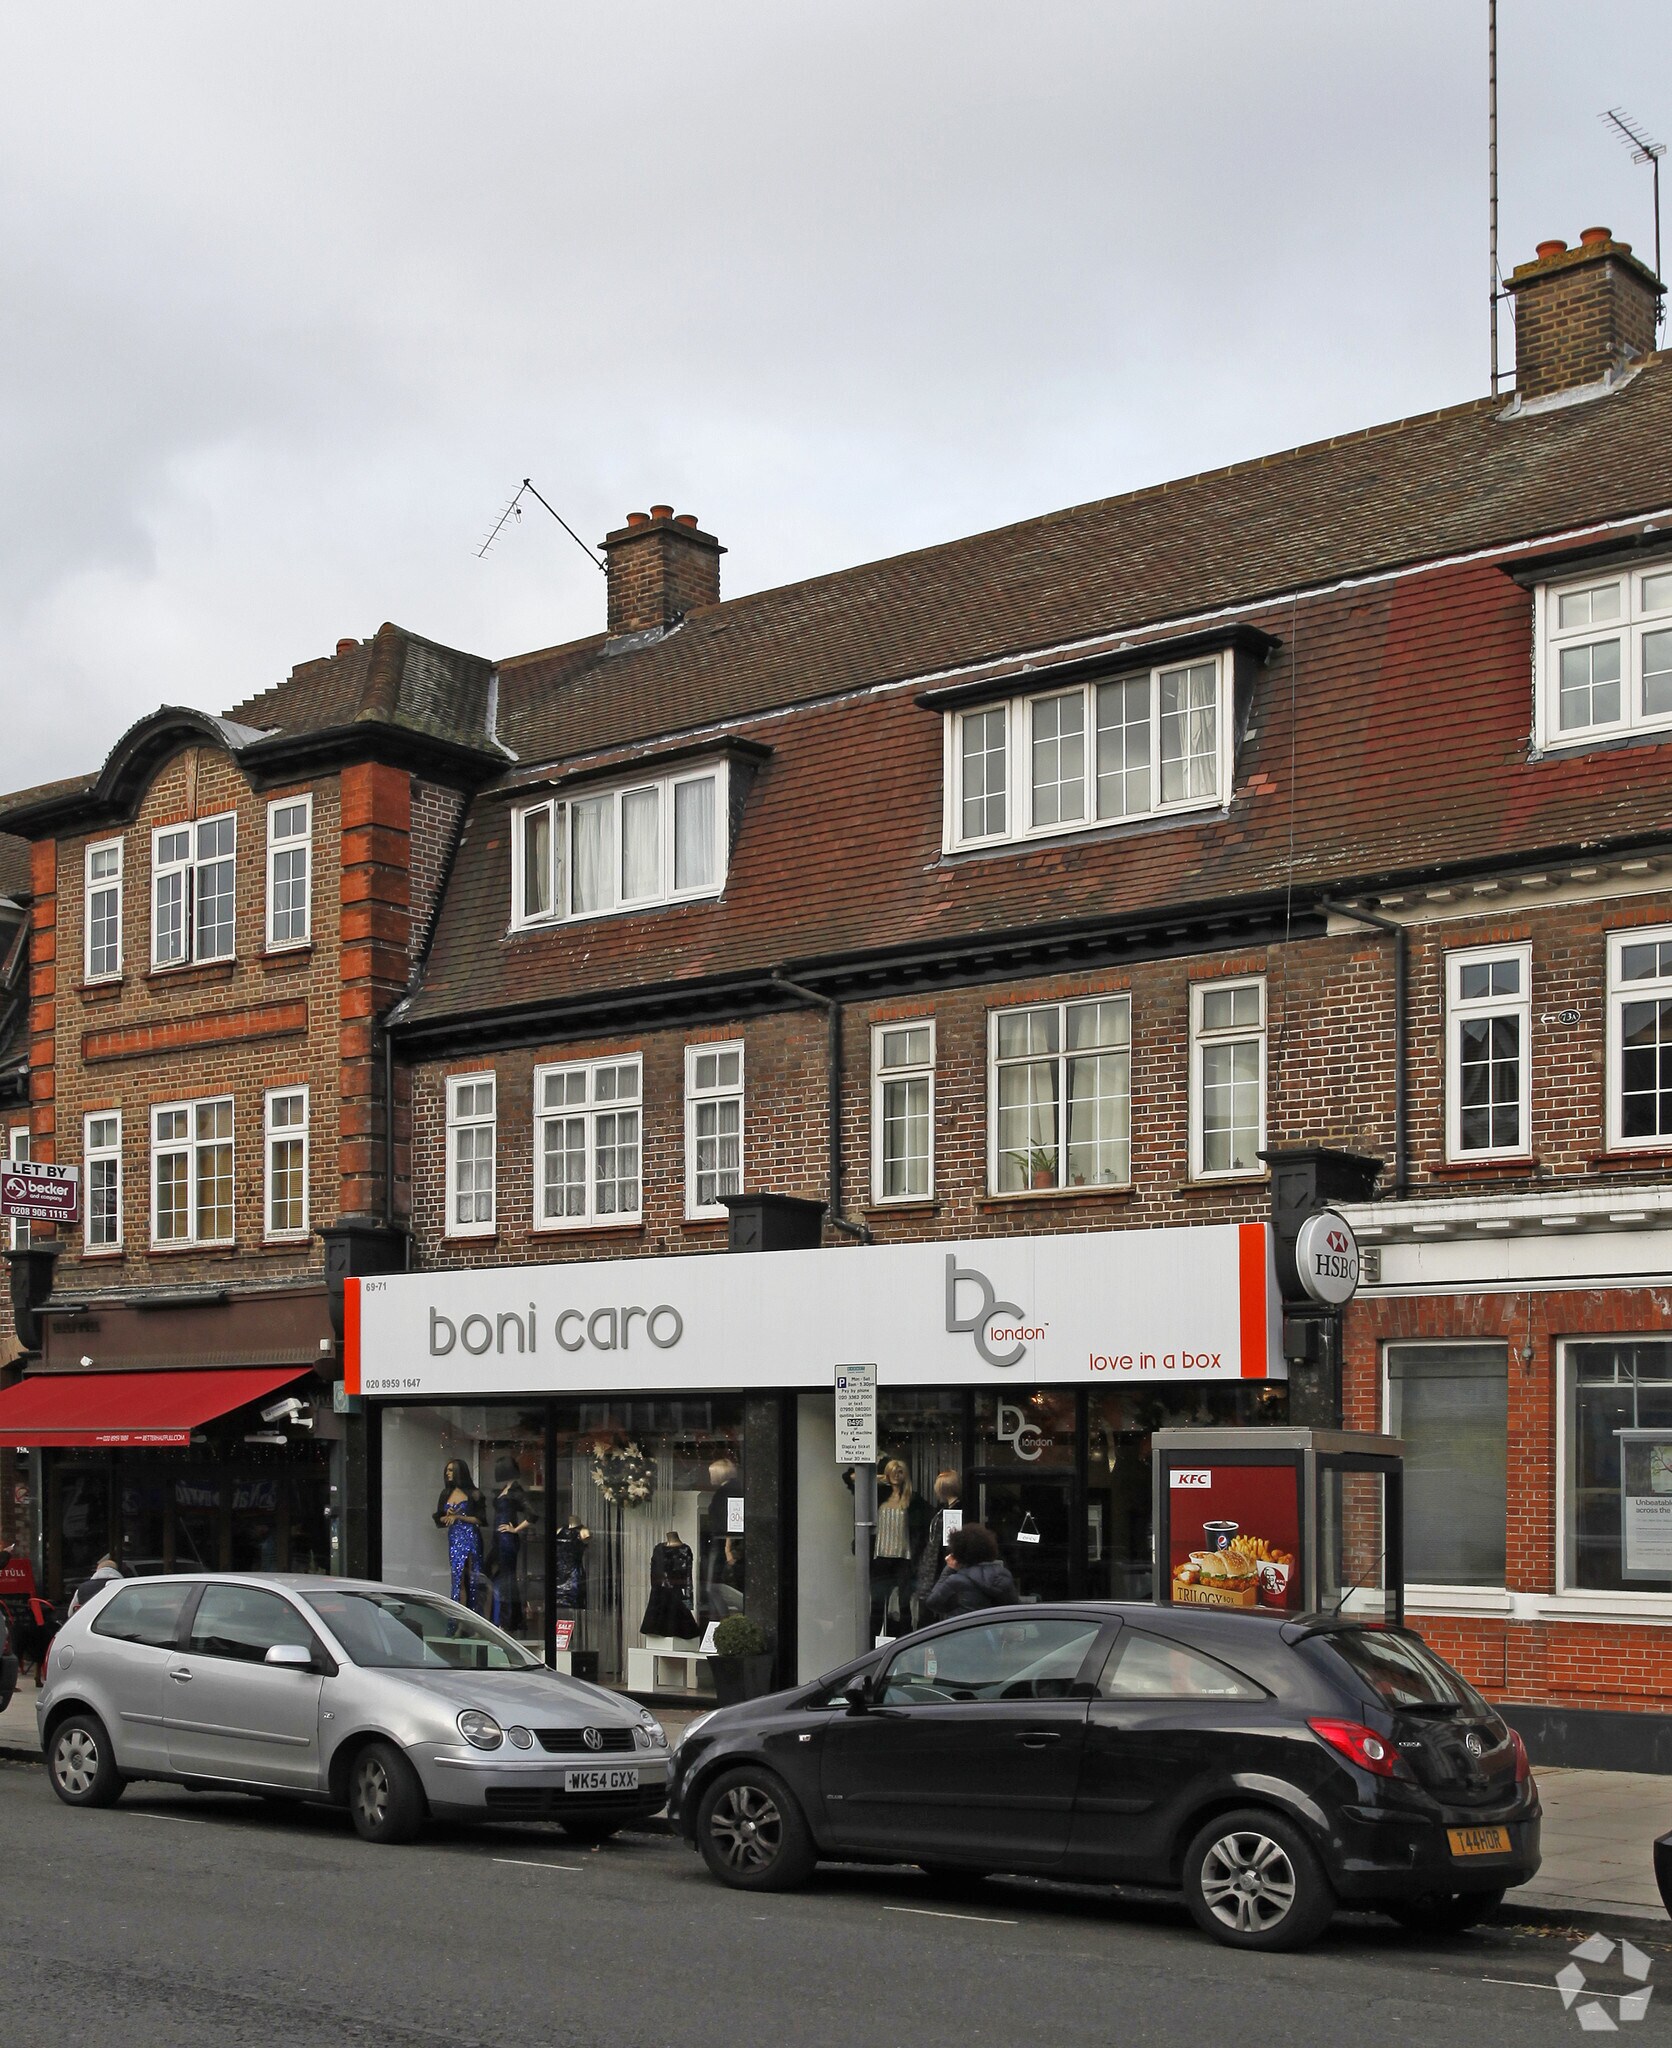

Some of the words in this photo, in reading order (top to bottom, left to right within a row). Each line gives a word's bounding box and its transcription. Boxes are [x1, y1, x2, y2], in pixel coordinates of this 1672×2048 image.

[13, 1163, 41, 1175] LET
[47, 1166, 67, 1178] BY
[28, 1180, 69, 1196] becker
[10, 1206, 30, 1215] 0208
[32, 1209, 47, 1217] 906
[49, 1210, 68, 1219] 1115
[1315, 1254, 1357, 1280] HSBC
[366, 1282, 387, 1291] 69-71
[430, 1302, 536, 1356] boni
[555, 1304, 683, 1352] caro
[990, 1325, 1045, 1341] london
[1089, 1353, 1133, 1371] love
[1139, 1352, 1156, 1369] in
[1163, 1354, 1176, 1369] a
[1182, 1351, 1222, 1369] box
[366, 1380, 380, 1389] 020
[381, 1379, 400, 1388] 8959
[402, 1378, 421, 1388] 1647
[1178, 1474, 1208, 1484] KFC
[1177, 1587, 1222, 1604] TRILOGY
[572, 1773, 607, 1789] WK54
[611, 1771, 634, 1787] GXX
